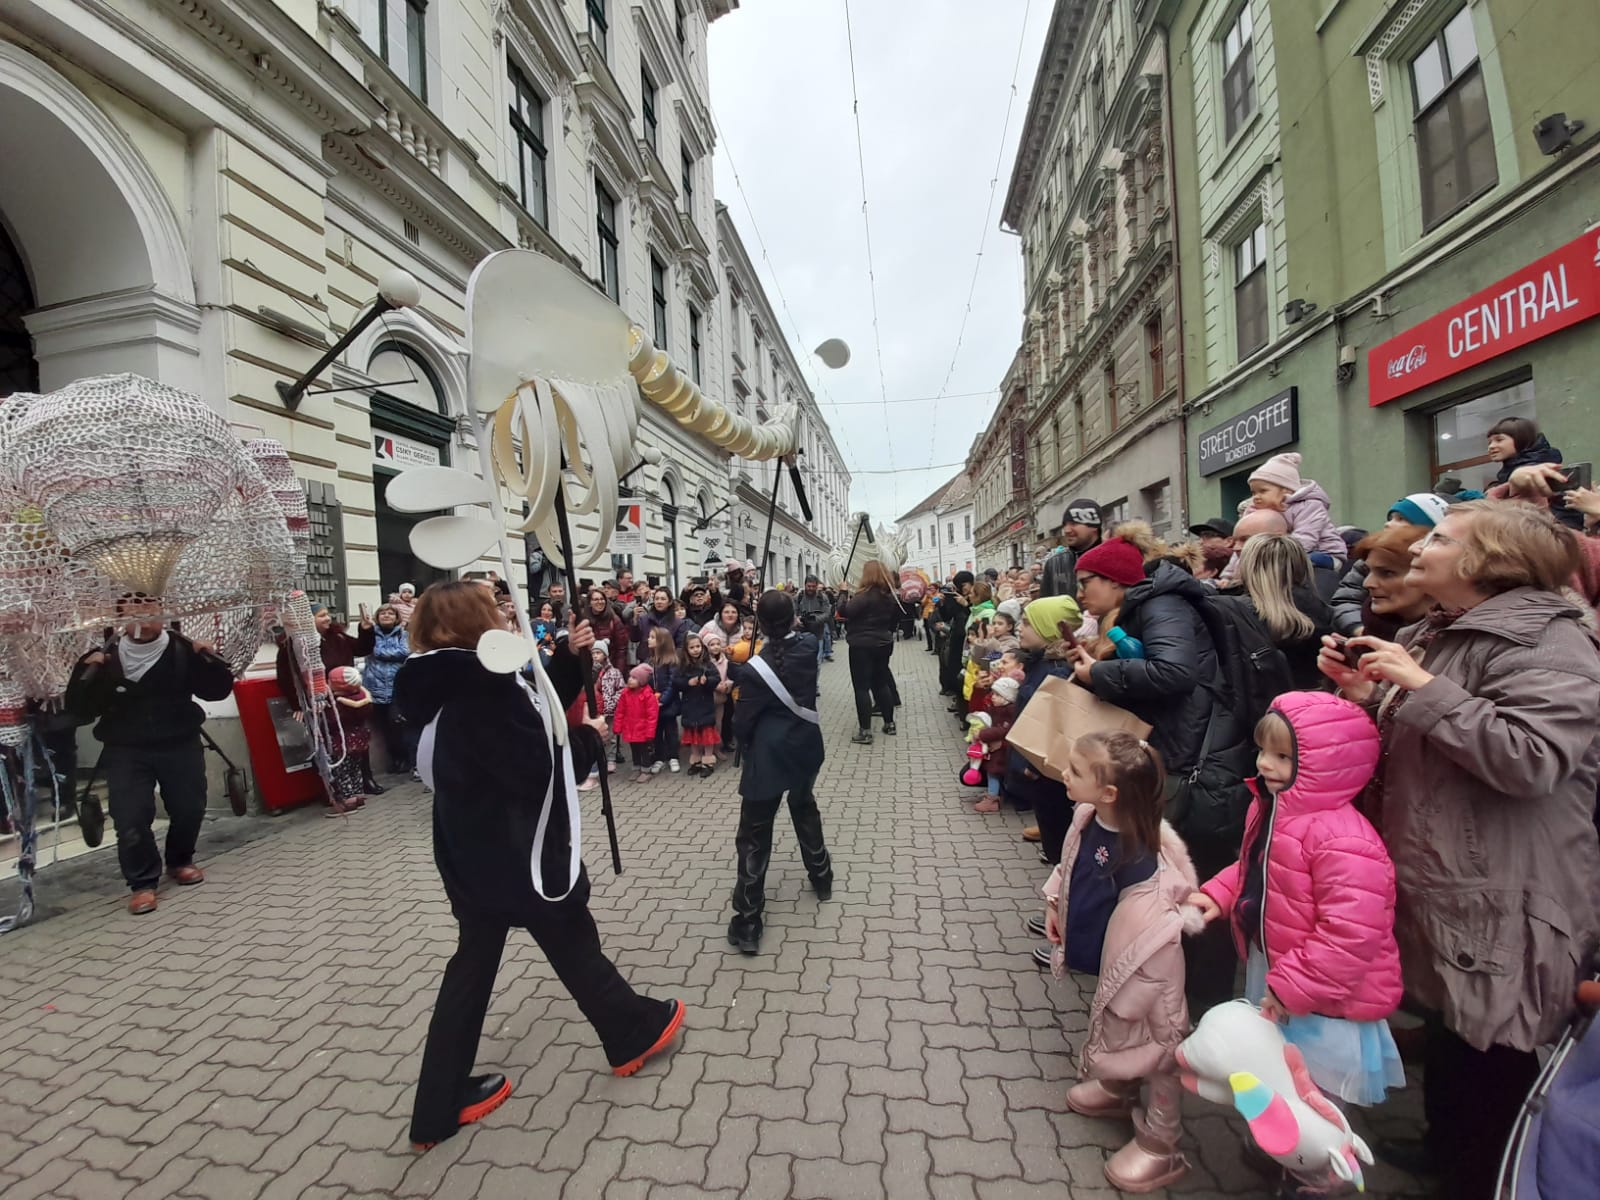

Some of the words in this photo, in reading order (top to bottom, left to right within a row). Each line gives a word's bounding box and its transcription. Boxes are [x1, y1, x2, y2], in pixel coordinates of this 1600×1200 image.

[1447, 263, 1580, 358] CENTRAL
[1200, 425, 1234, 460] STREET
[1235, 397, 1289, 443] COFFEE
[1225, 441, 1256, 463] ROASTERS
